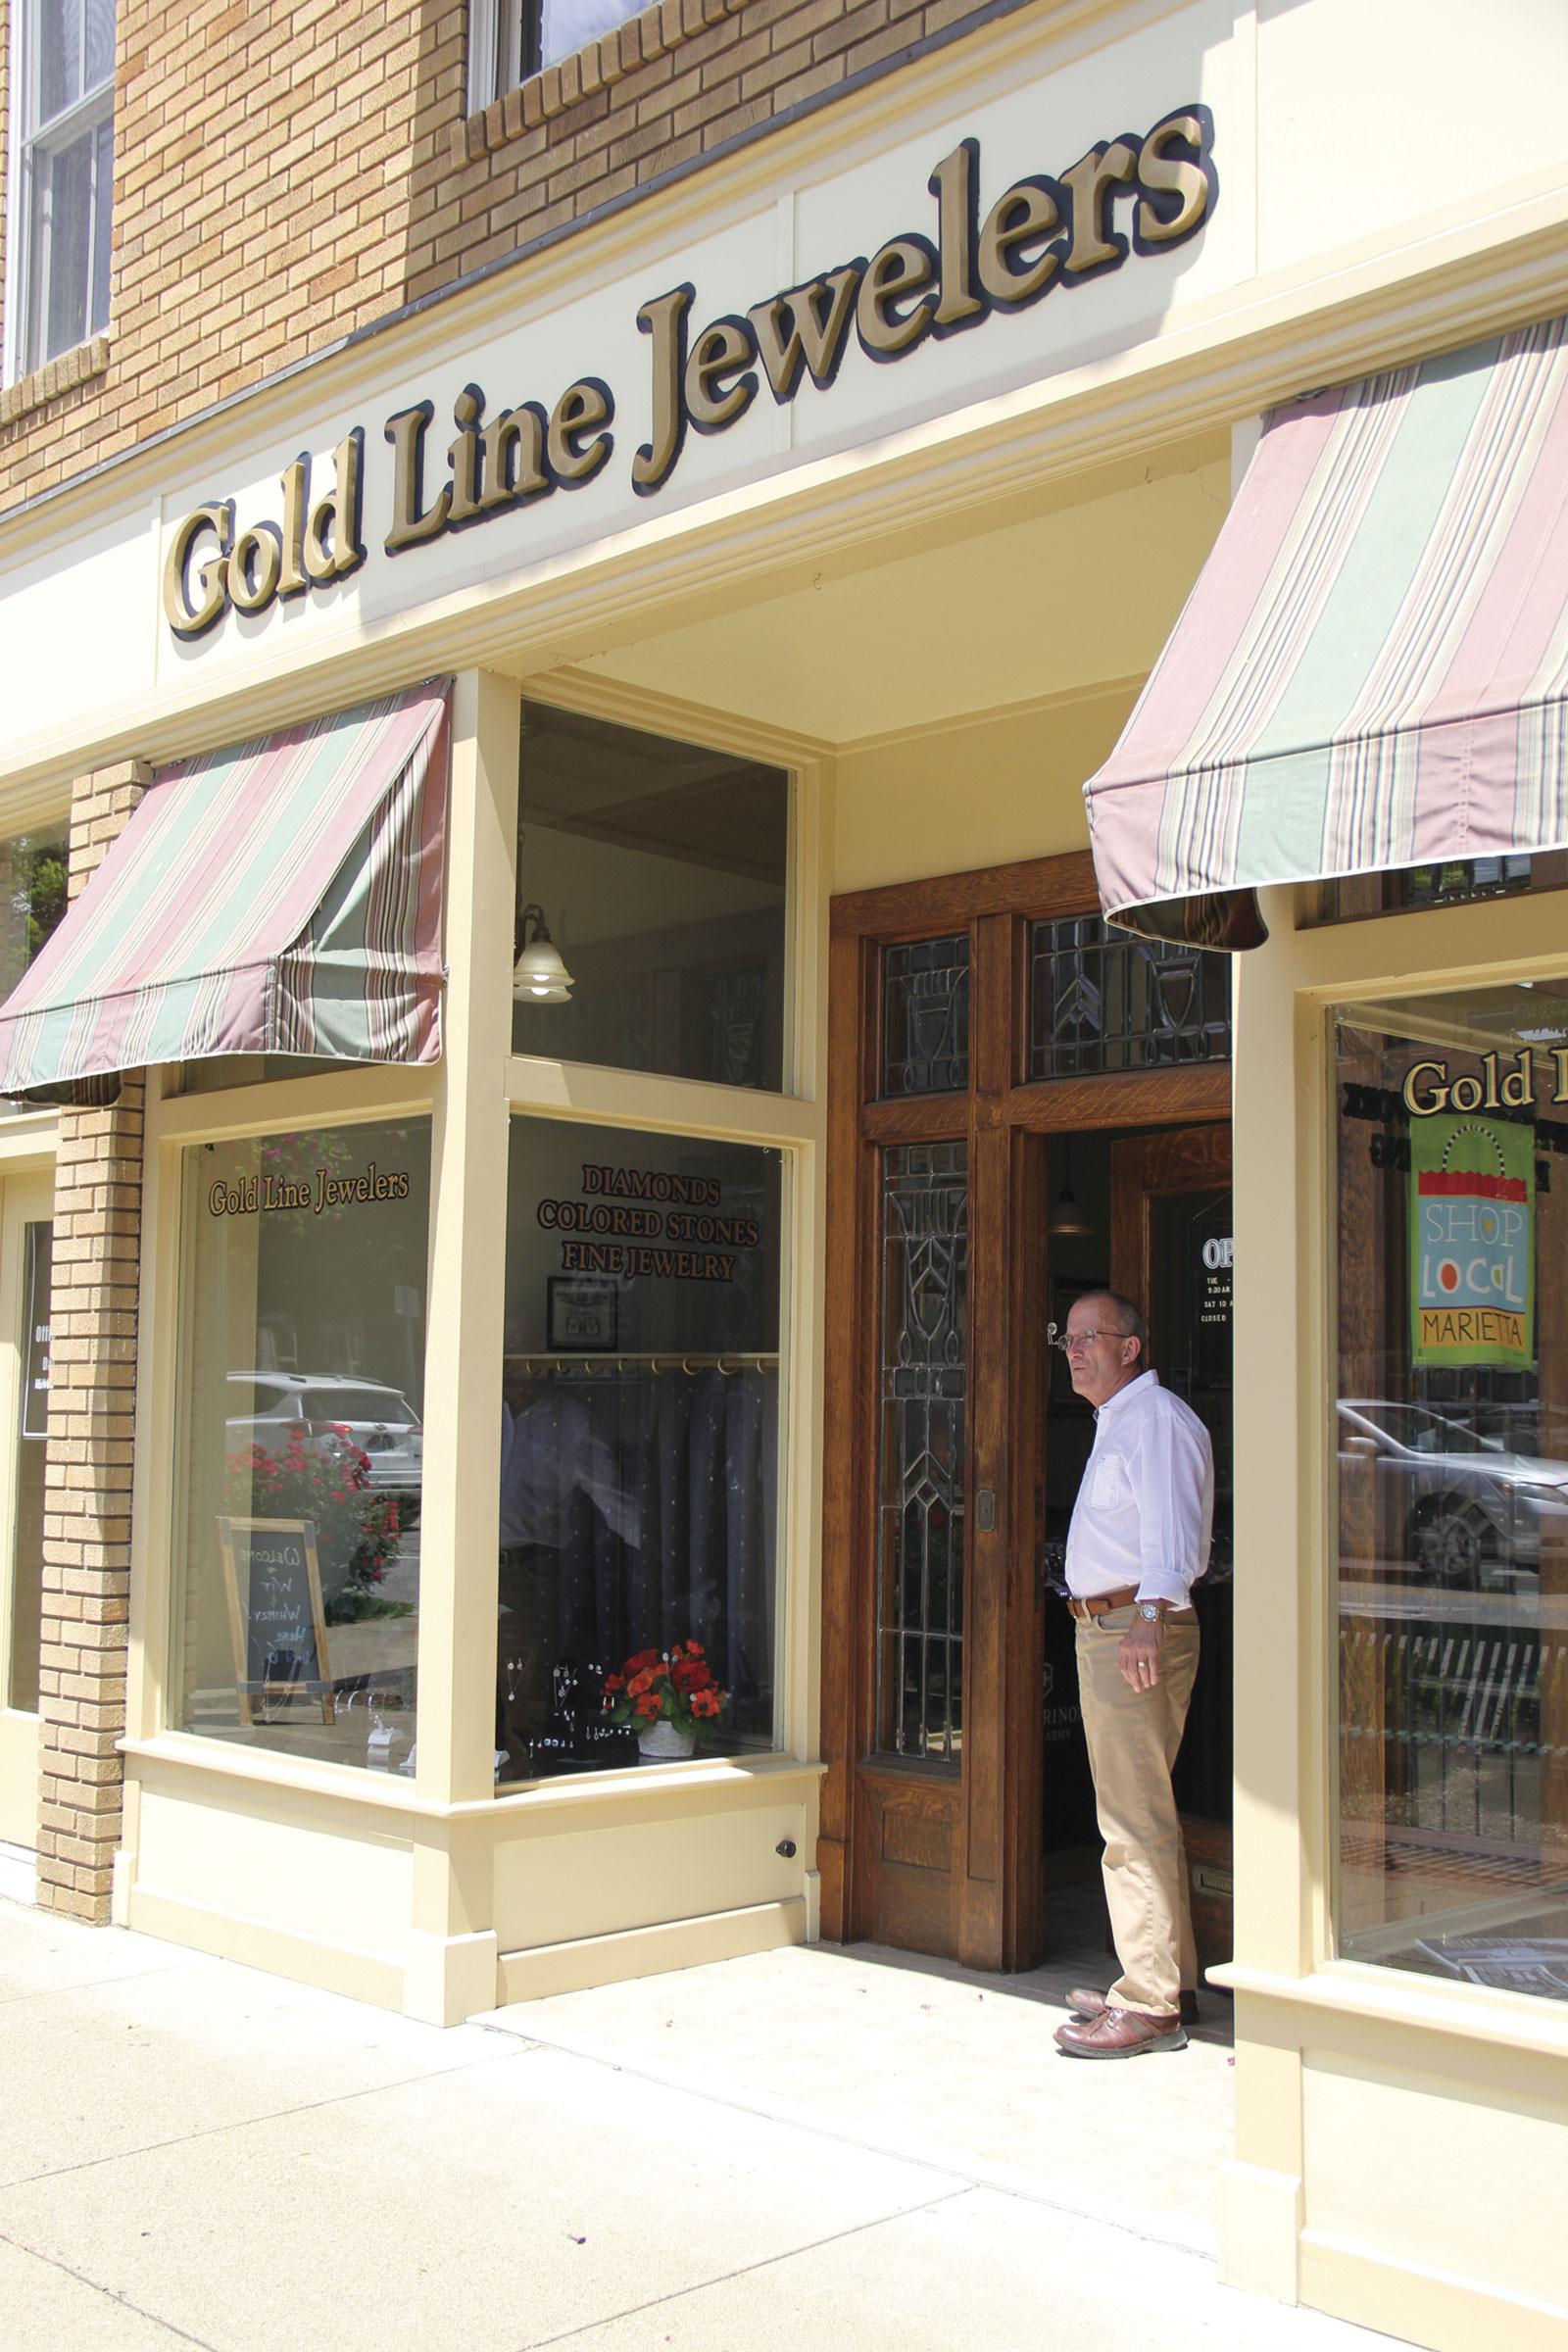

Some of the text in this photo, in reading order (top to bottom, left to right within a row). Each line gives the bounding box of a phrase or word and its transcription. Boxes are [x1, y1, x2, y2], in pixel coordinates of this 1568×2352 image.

[162, 104, 1220, 641] Gold Line Jewelers
[1401, 1046, 1536, 1117] Gold
[209, 1161, 410, 1216] Gold Line Jewelers
[582, 1164, 720, 1206] DIAMONDS
[537, 1199, 760, 1246] COLORED STONES
[1425, 1202, 1525, 1248] SHOP
[562, 1241, 623, 1272] FINE
[625, 1247, 736, 1283] JEWELRY
[1421, 1311, 1524, 1347] MARIETTA
